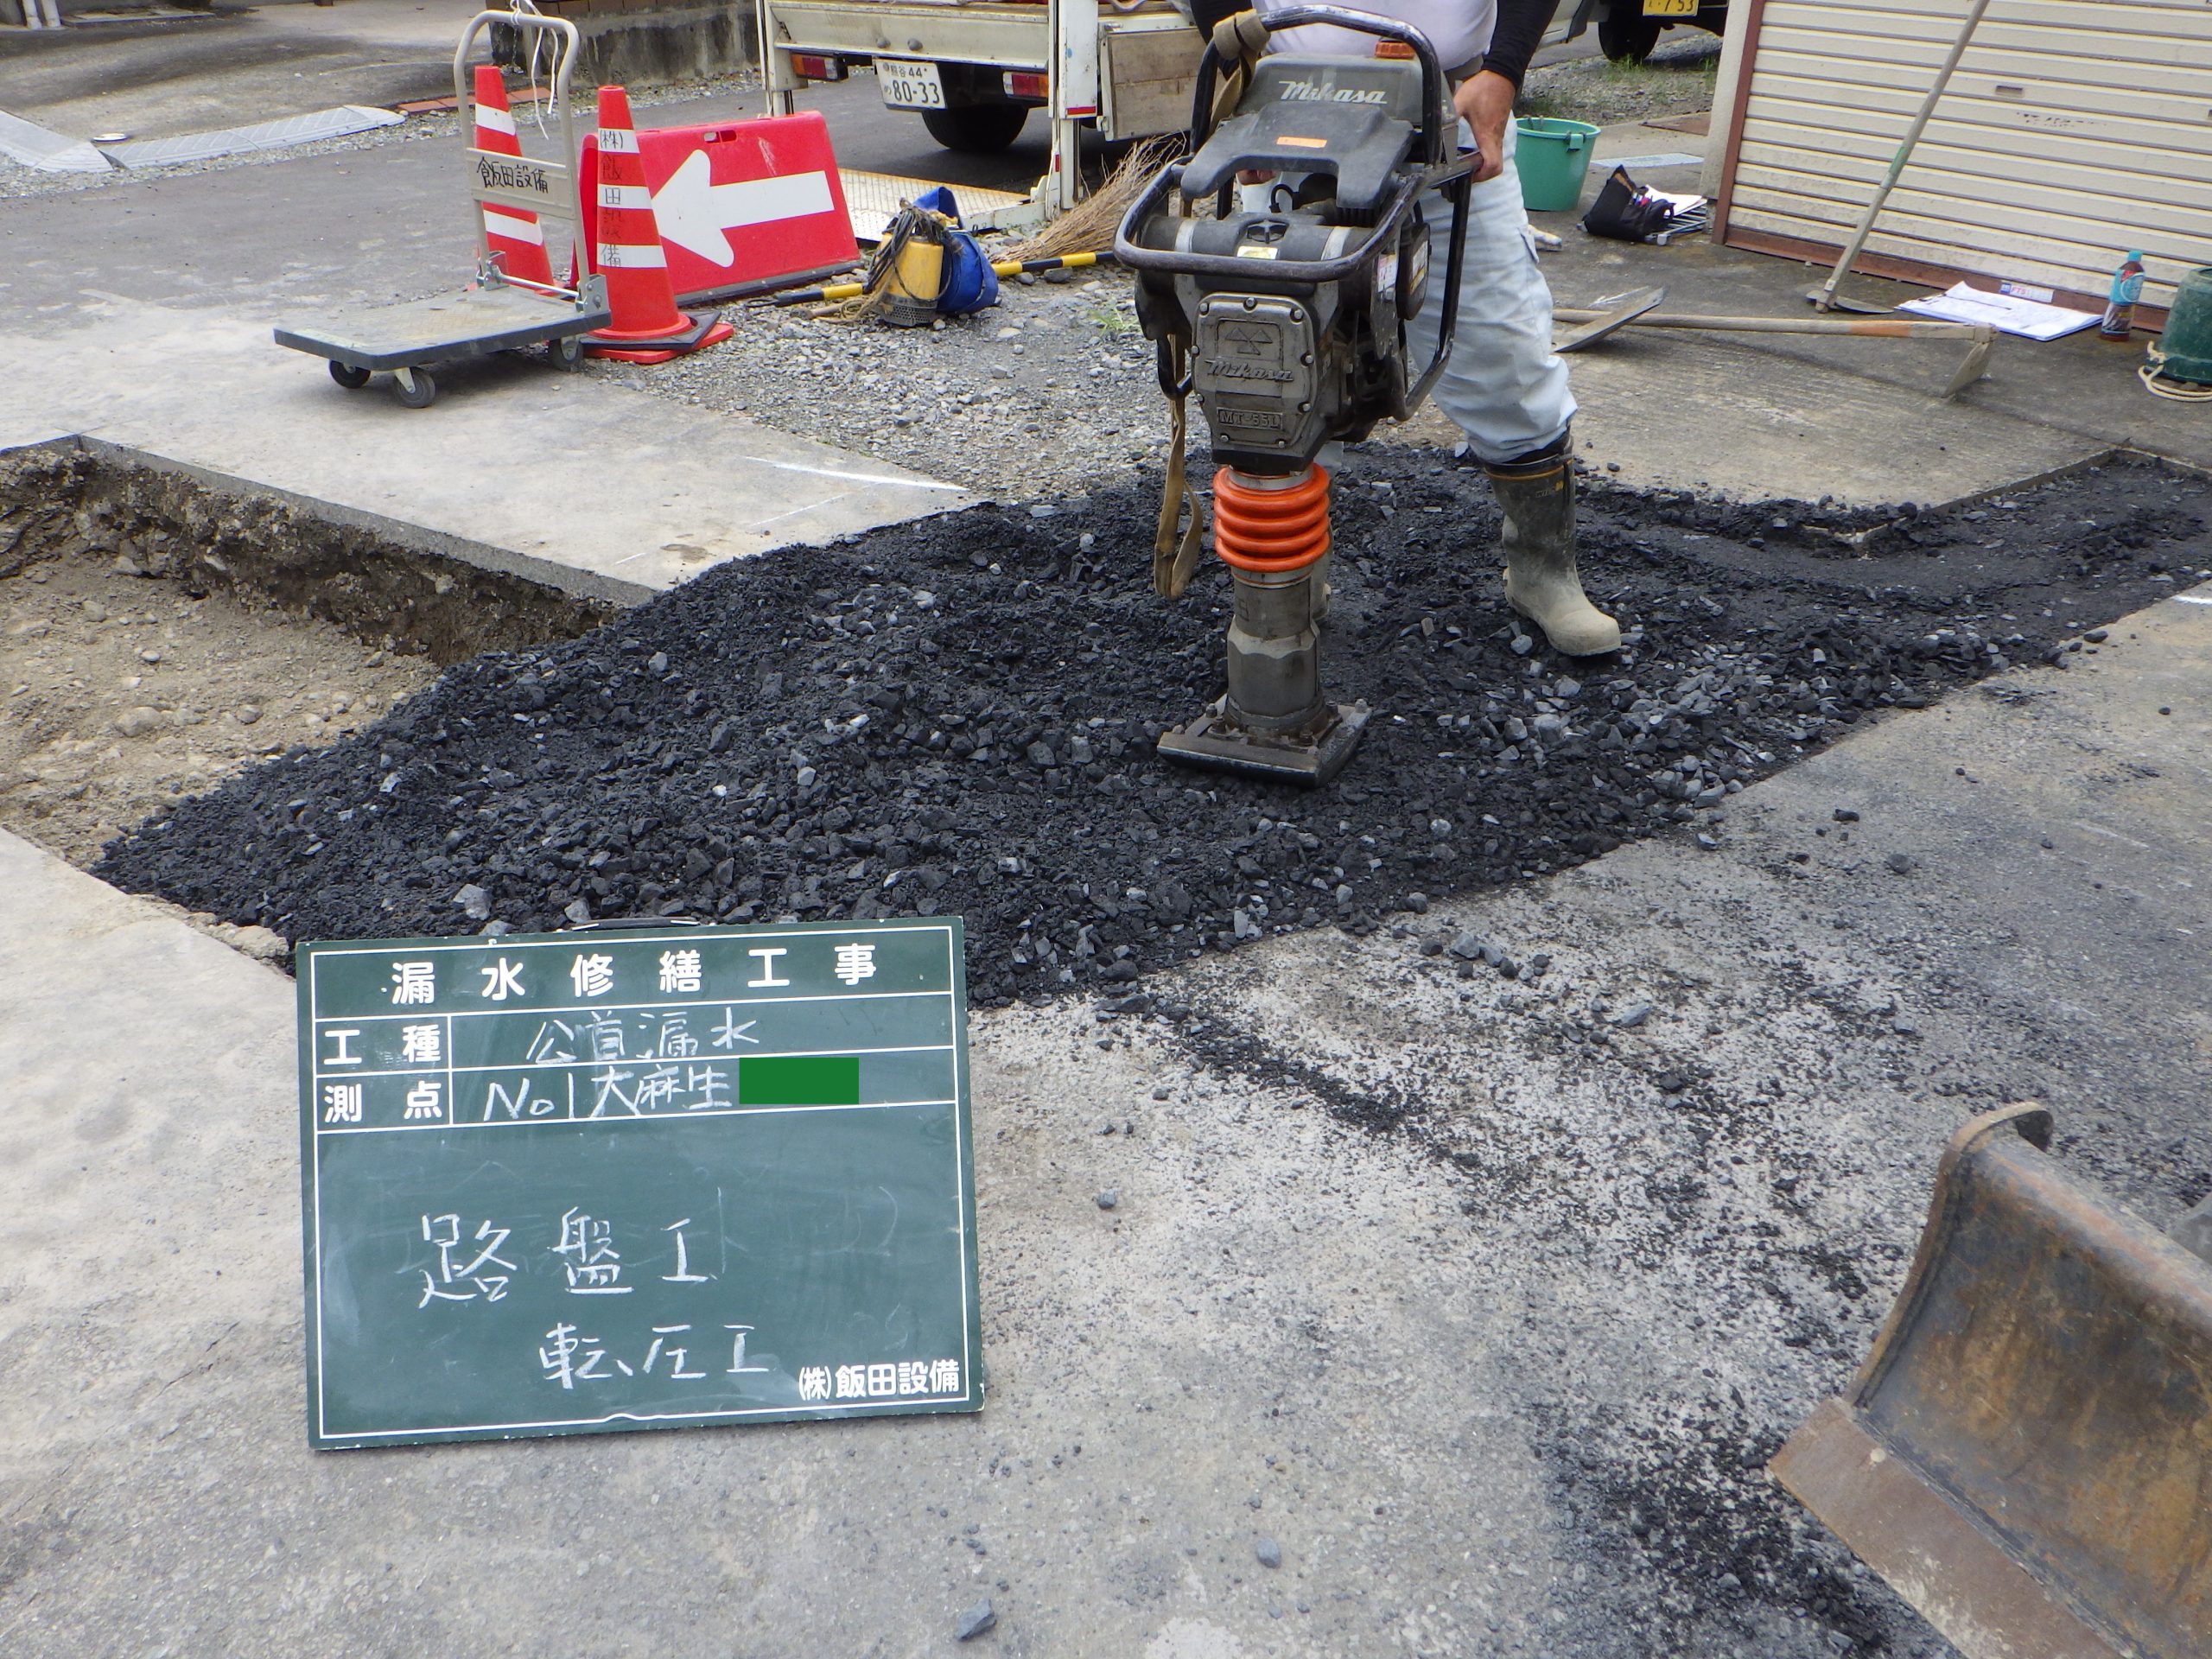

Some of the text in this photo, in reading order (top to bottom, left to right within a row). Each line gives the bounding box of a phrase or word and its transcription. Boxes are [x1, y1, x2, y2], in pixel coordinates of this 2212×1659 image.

[908, 67, 923, 79] 44
[893, 79, 940, 104] 80-33
[1279, 80, 1388, 105] Mikasa
[476, 156, 550, 194] 飯田設備
[1205, 356, 1294, 382] Mikasa
[391, 942, 877, 1005] 漏水修繕工事
[323, 1024, 442, 1065] 工種
[323, 1080, 443, 1123] 測点
